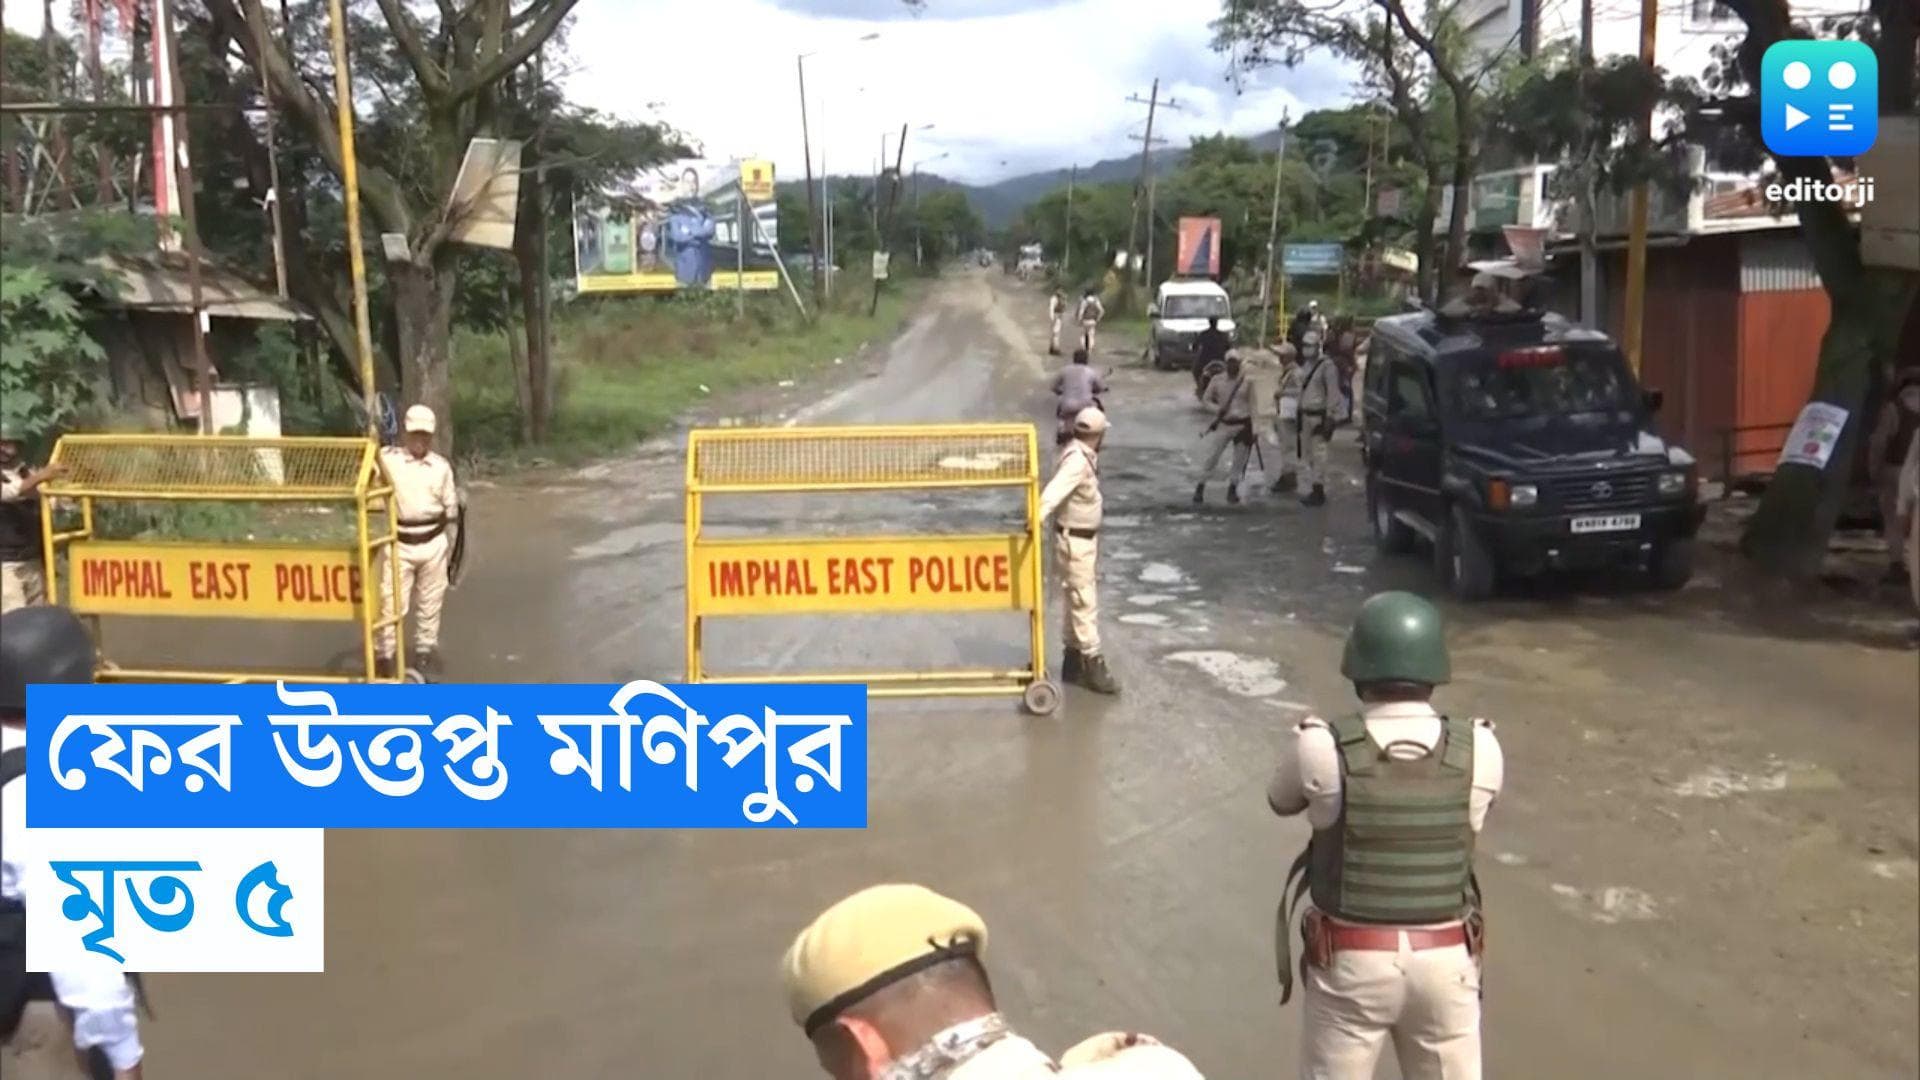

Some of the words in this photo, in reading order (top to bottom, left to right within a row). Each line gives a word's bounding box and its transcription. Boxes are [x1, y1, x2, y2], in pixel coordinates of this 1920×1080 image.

[81, 558, 172, 599] IMPHAL
[189, 560, 251, 601] EAST
[275, 563, 363, 604] POLICE
[709, 557, 818, 599] IMPHAL
[826, 557, 894, 597] EAST
[909, 554, 1010, 594] POLICE
